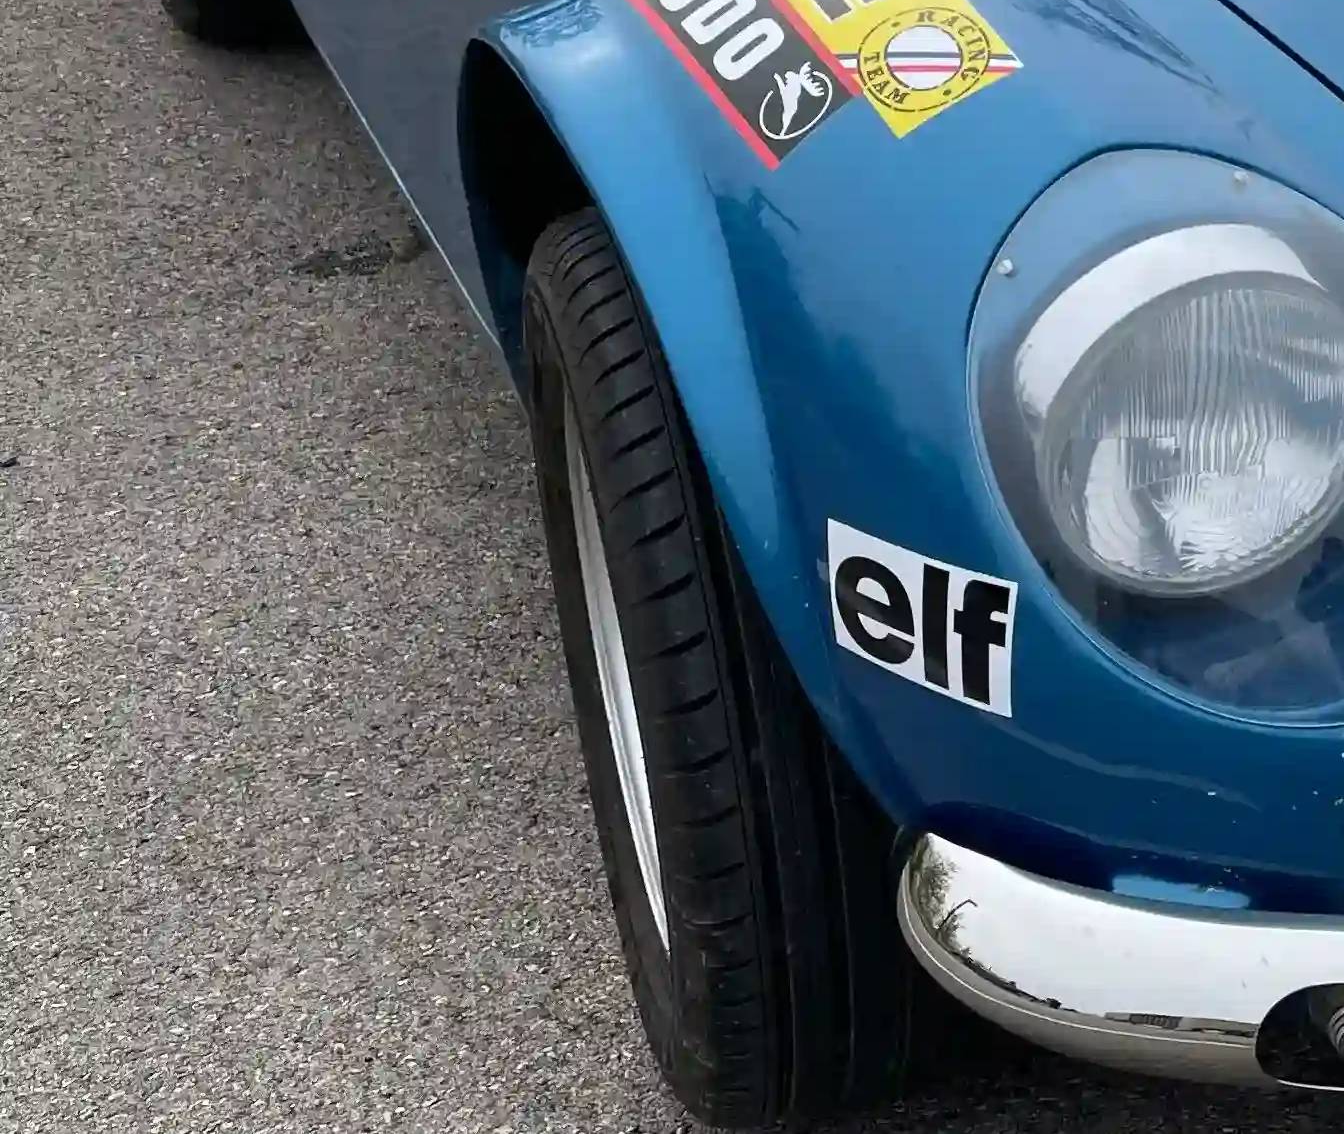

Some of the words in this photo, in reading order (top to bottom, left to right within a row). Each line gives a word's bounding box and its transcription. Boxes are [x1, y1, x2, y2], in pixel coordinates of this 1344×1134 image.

[863, 51, 911, 105] TEAM
[916, 9, 987, 82] RACING
[834, 555, 1011, 705] elf
